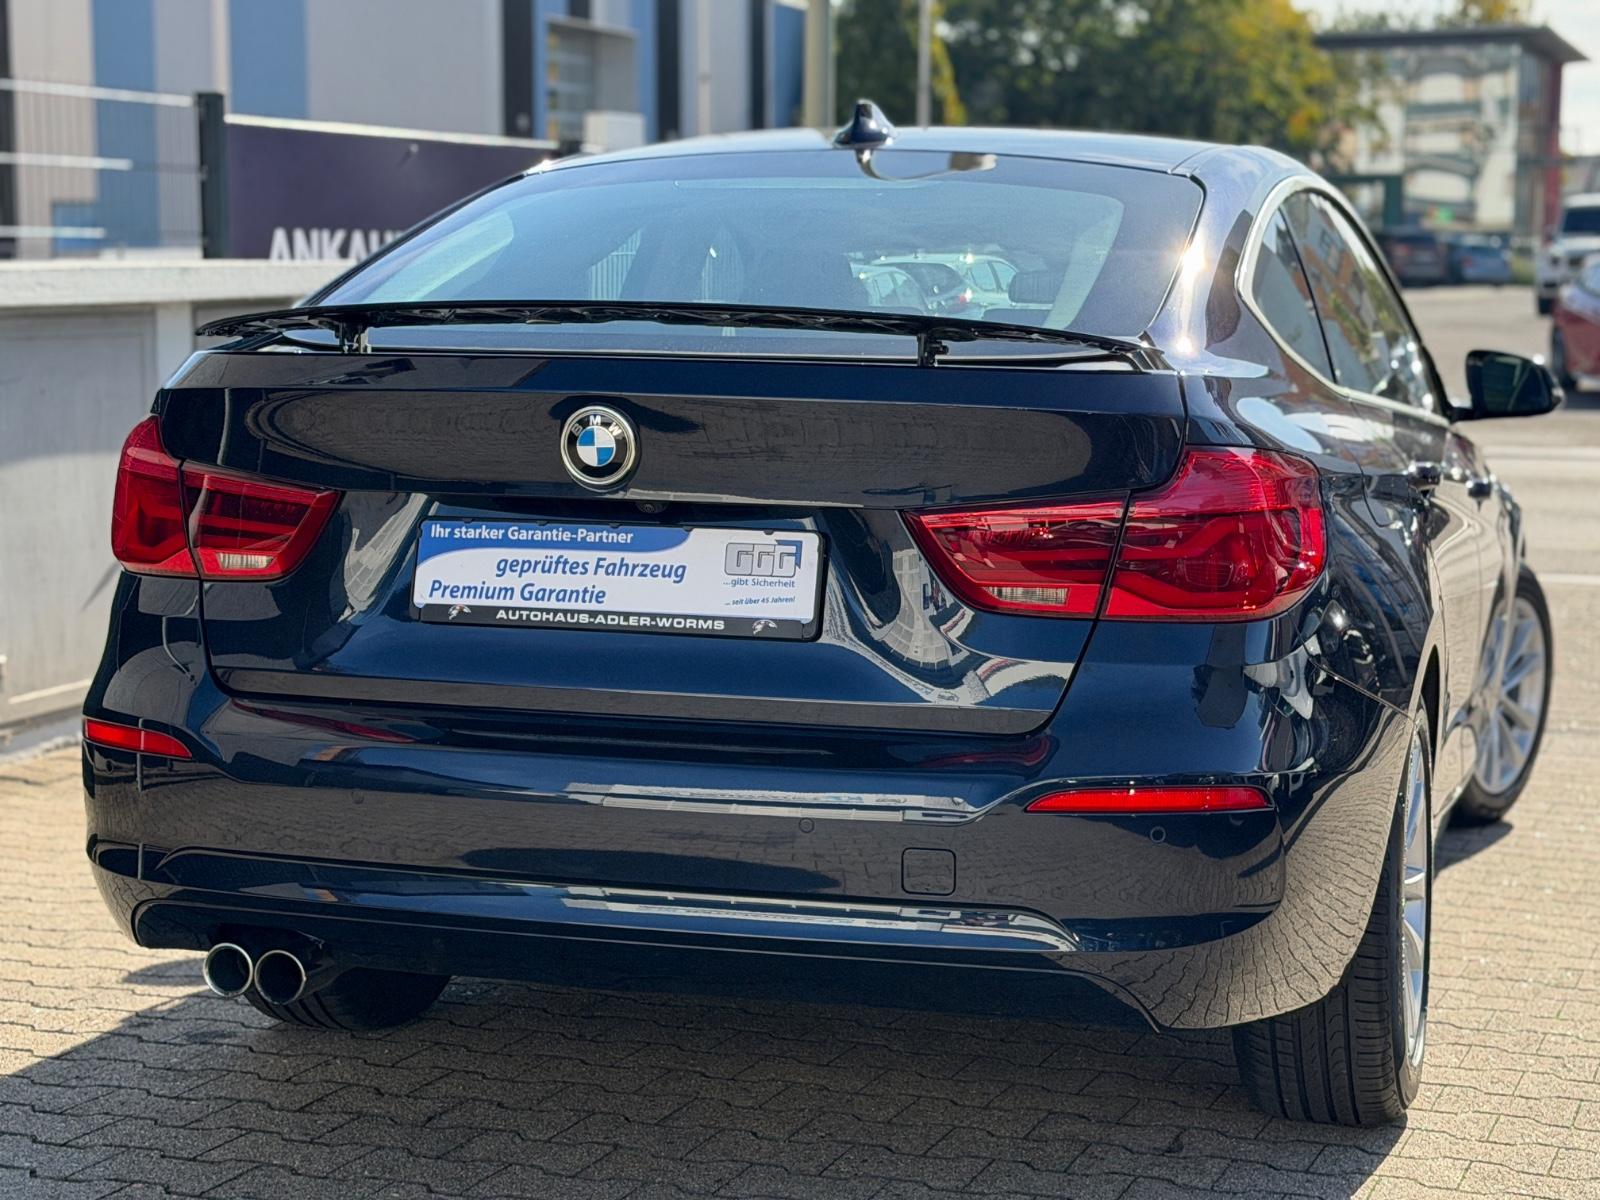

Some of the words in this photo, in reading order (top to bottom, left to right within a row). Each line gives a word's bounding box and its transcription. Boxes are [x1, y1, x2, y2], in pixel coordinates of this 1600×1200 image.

[570, 414, 623, 437] BMW
[431, 524, 451, 538] Ihr
[454, 526, 504, 540] starker
[508, 526, 634, 543] Garantie-Partner
[496, 555, 590, 578] geprüftes
[594, 558, 687, 584] Fahrzeug
[428, 580, 515, 600] Premium
[520, 583, 606, 604] Garantie
[751, 578, 795, 588] Sicherheit
[744, 598, 760, 606] über
[771, 596, 796, 604] Jahren!
[496, 610, 725, 630] AUTOHAUS-ADLER-WORMS
